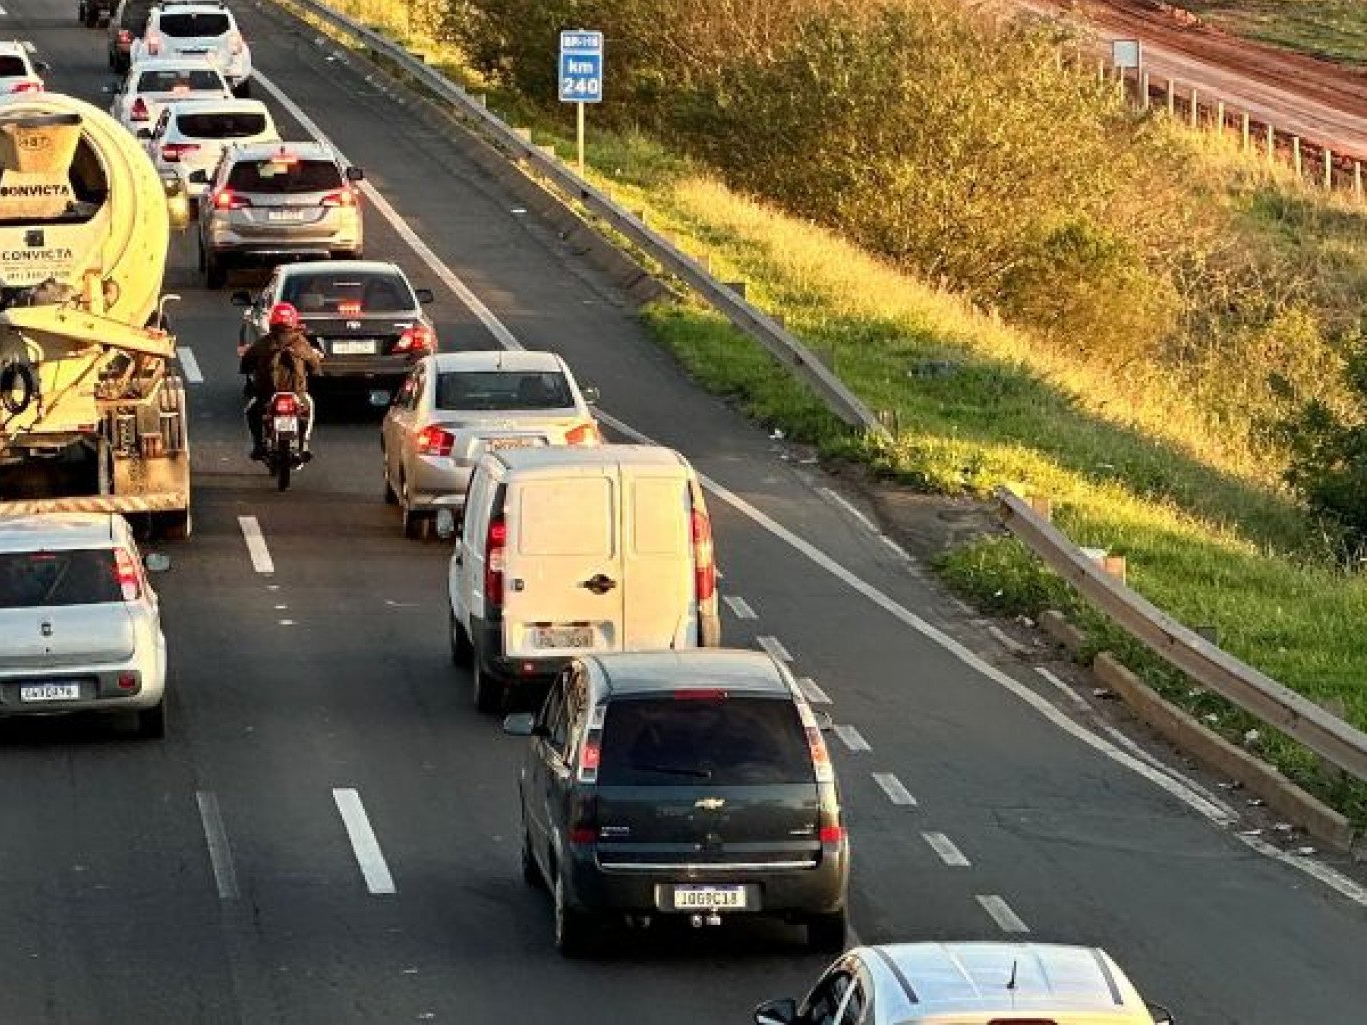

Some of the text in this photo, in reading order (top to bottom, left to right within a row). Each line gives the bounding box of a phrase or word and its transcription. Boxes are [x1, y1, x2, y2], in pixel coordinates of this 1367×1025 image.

[569, 59, 594, 74] km
[562, 77, 598, 94] 240
[2, 248, 72, 261] CONVICTA
